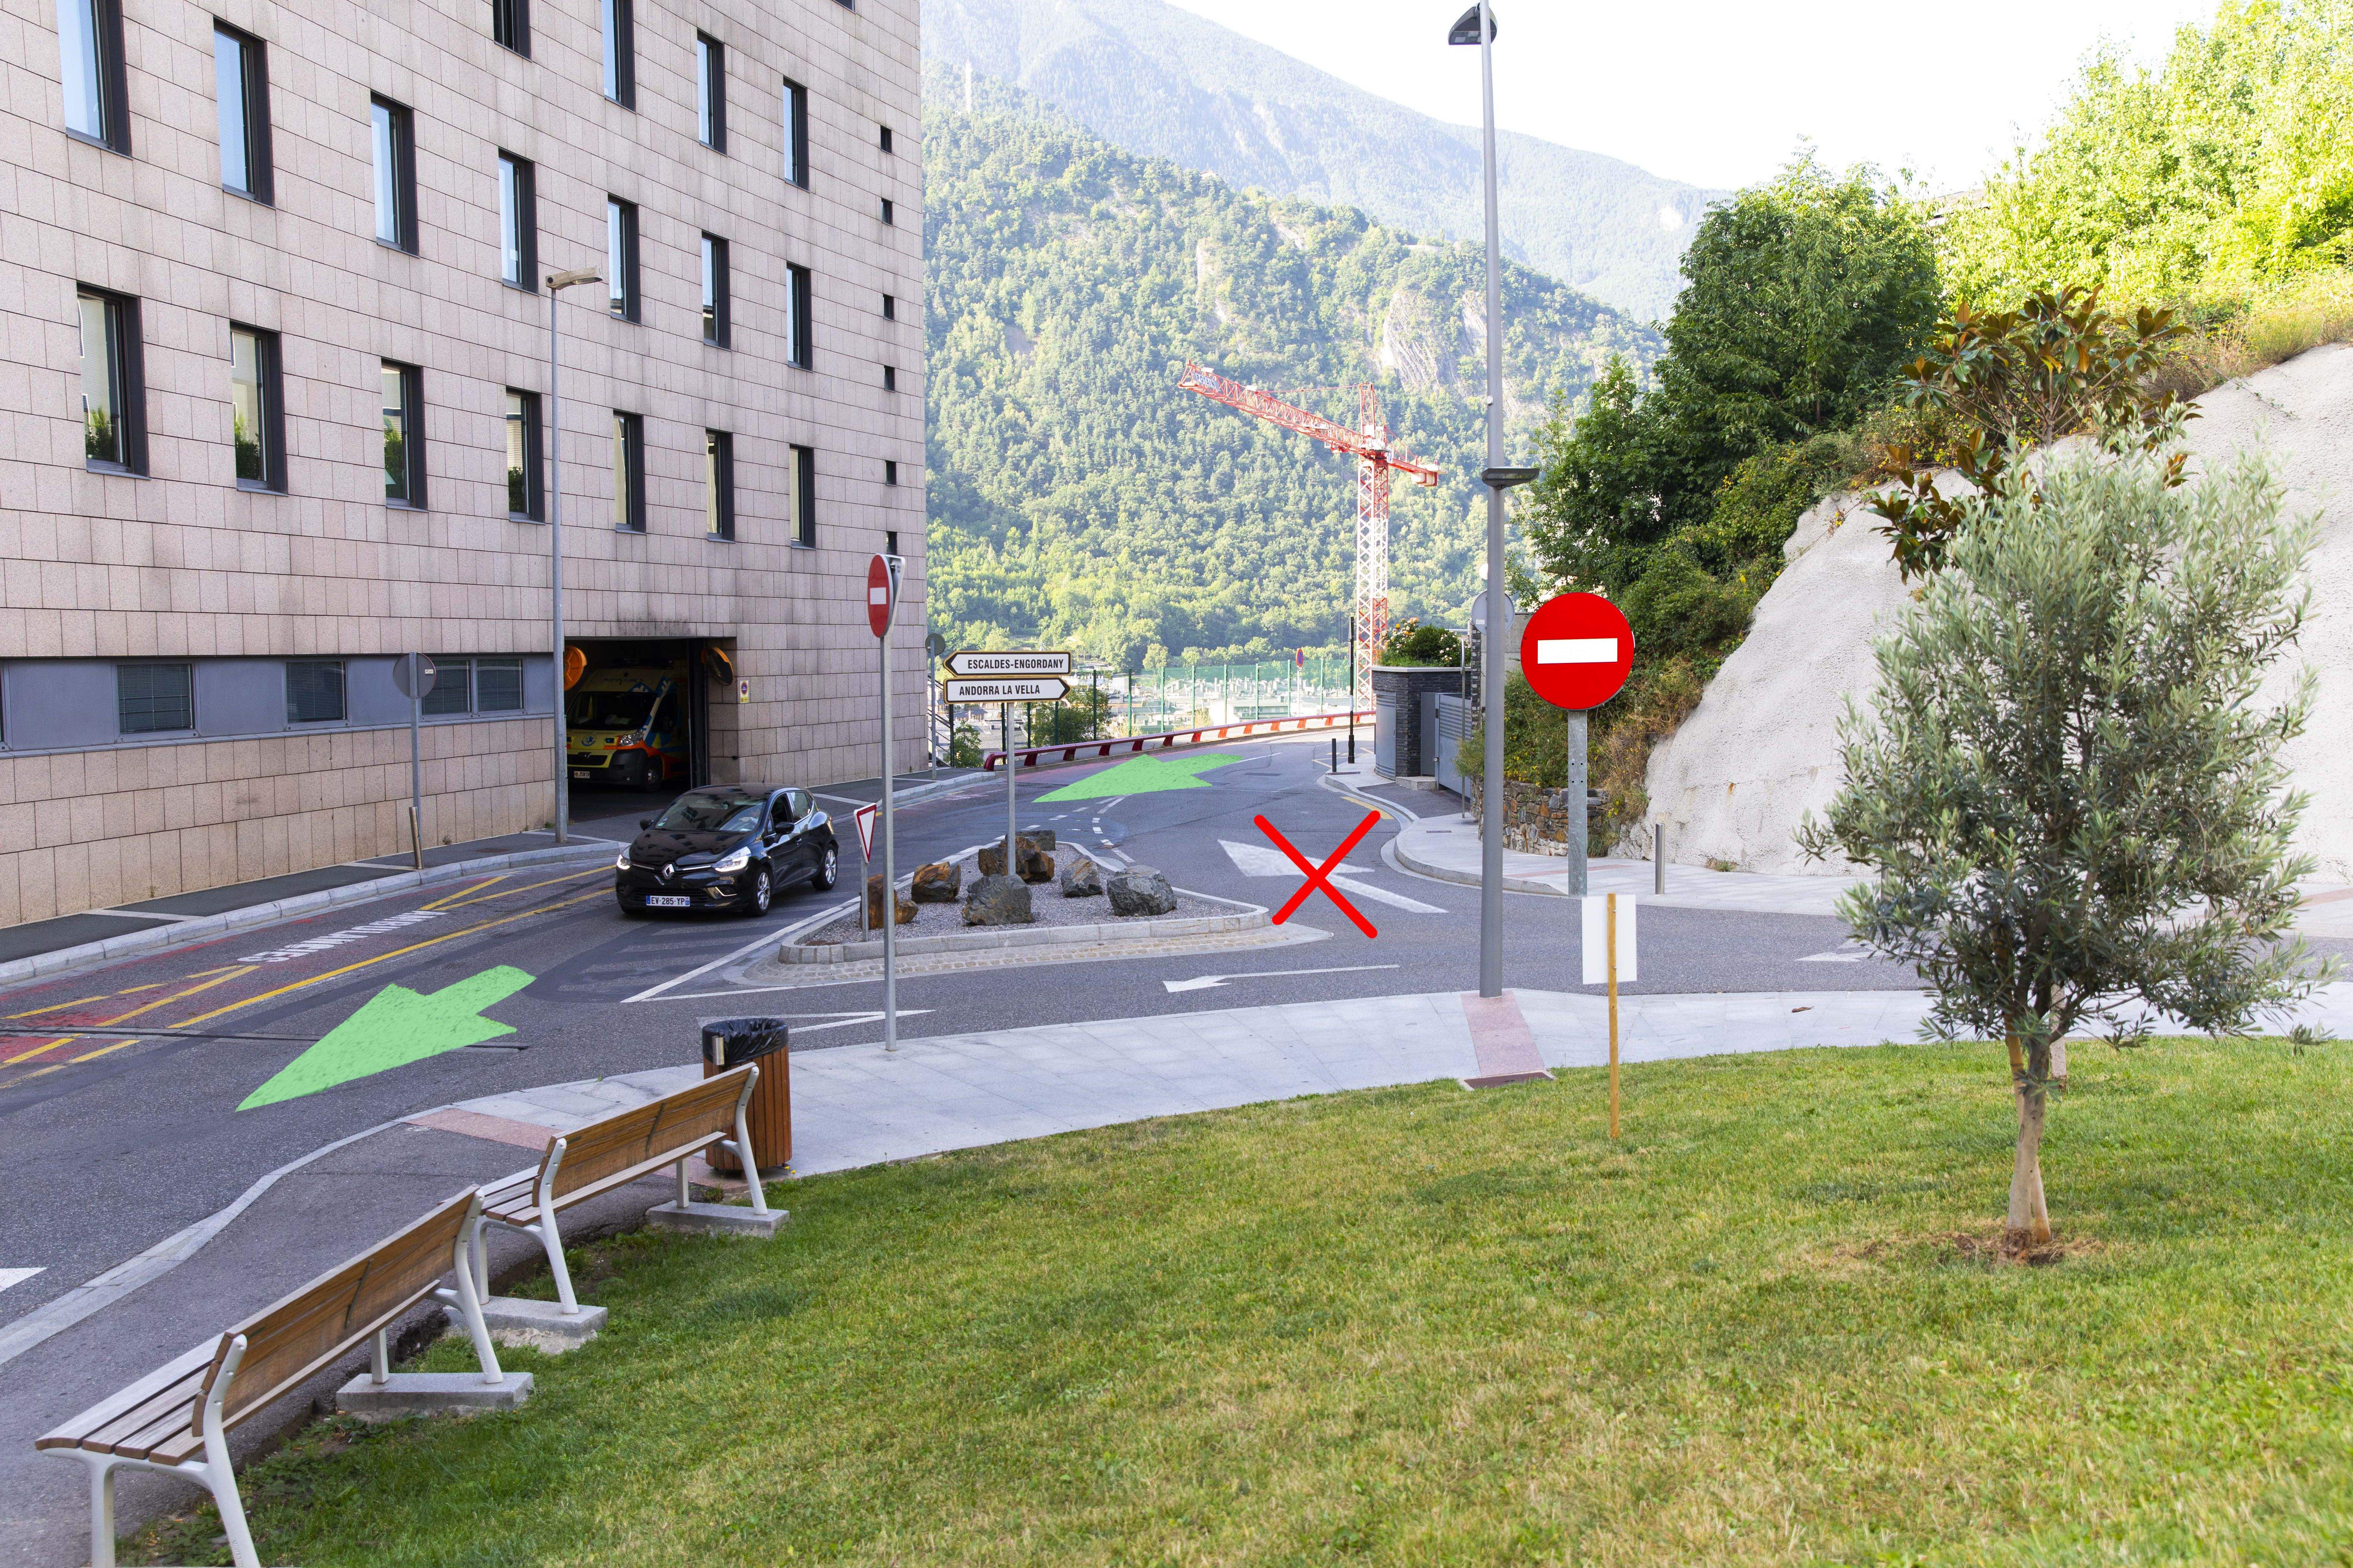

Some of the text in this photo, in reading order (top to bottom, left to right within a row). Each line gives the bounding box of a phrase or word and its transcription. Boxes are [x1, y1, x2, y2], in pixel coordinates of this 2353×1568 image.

[1196, 374, 1215, 388] POTAIN
[968, 659, 1064, 669] ESCALDES-ENGORDANY
[960, 685, 1040, 695] ANDORRA LA VELLA
[651, 897, 685, 905] EV-285-YP
